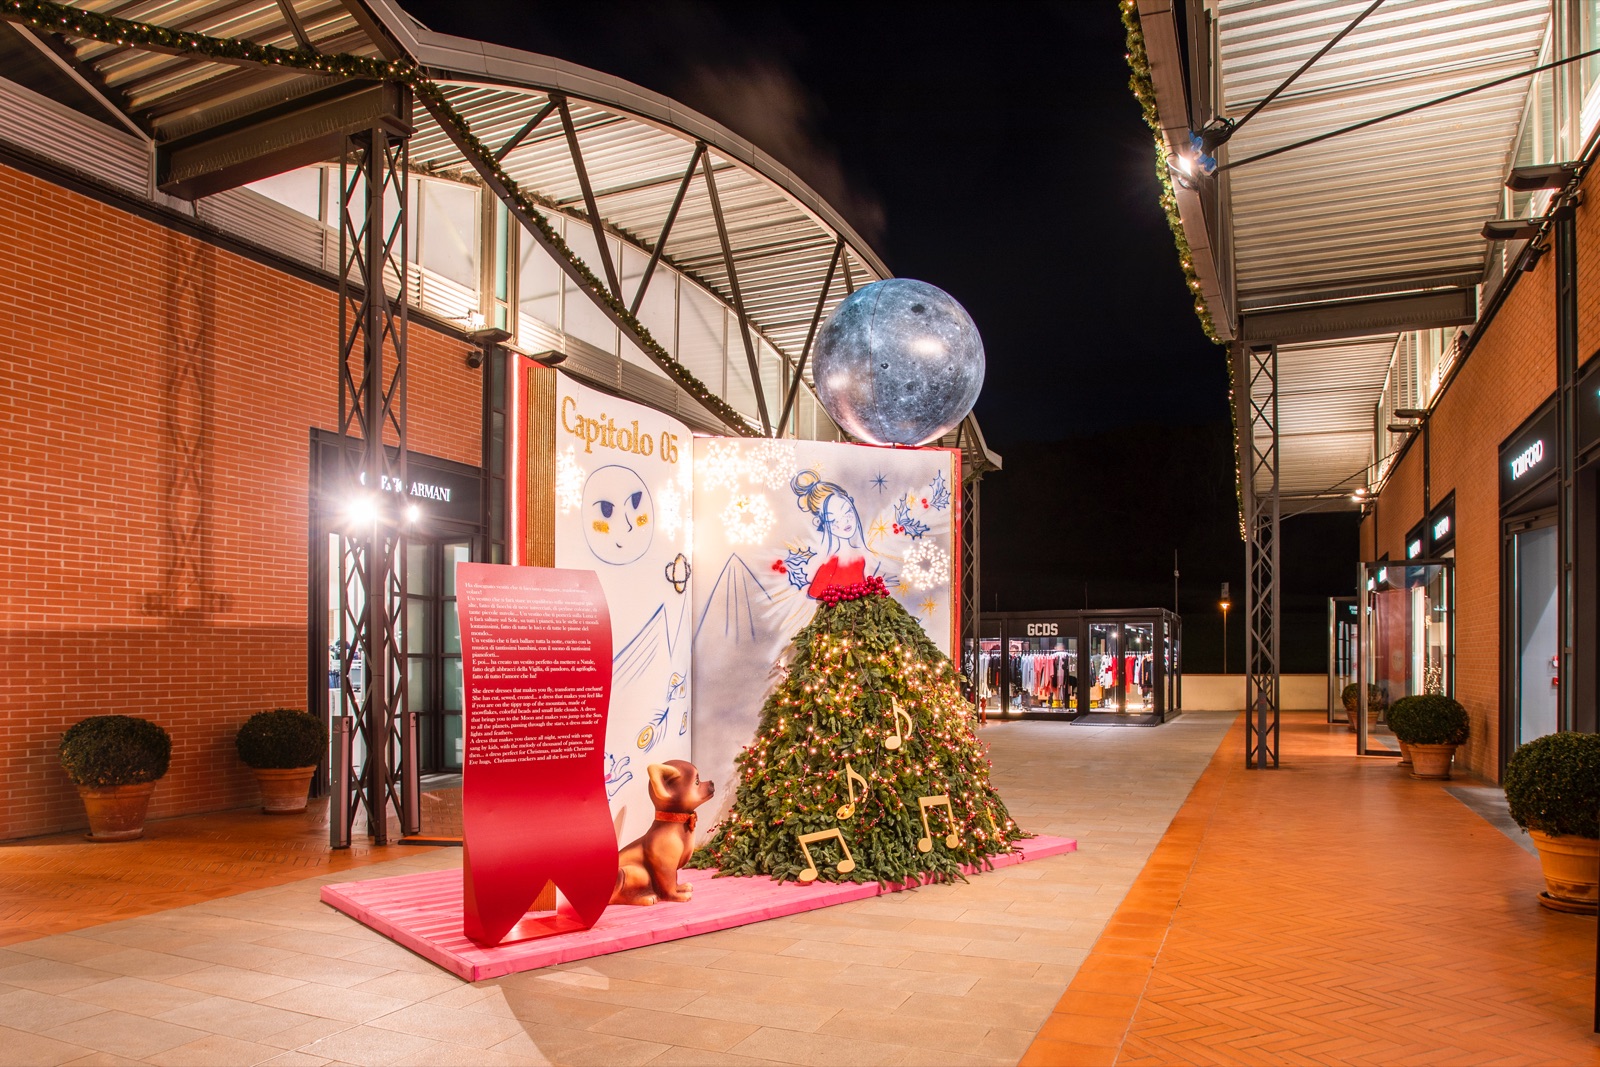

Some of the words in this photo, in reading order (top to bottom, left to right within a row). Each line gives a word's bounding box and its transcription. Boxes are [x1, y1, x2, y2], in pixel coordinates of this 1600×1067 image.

[561, 395, 654, 456] Capitolo
[660, 431, 679, 464] 05
[410, 482, 450, 502] ARMANI
[1027, 623, 1058, 636] GCDS
